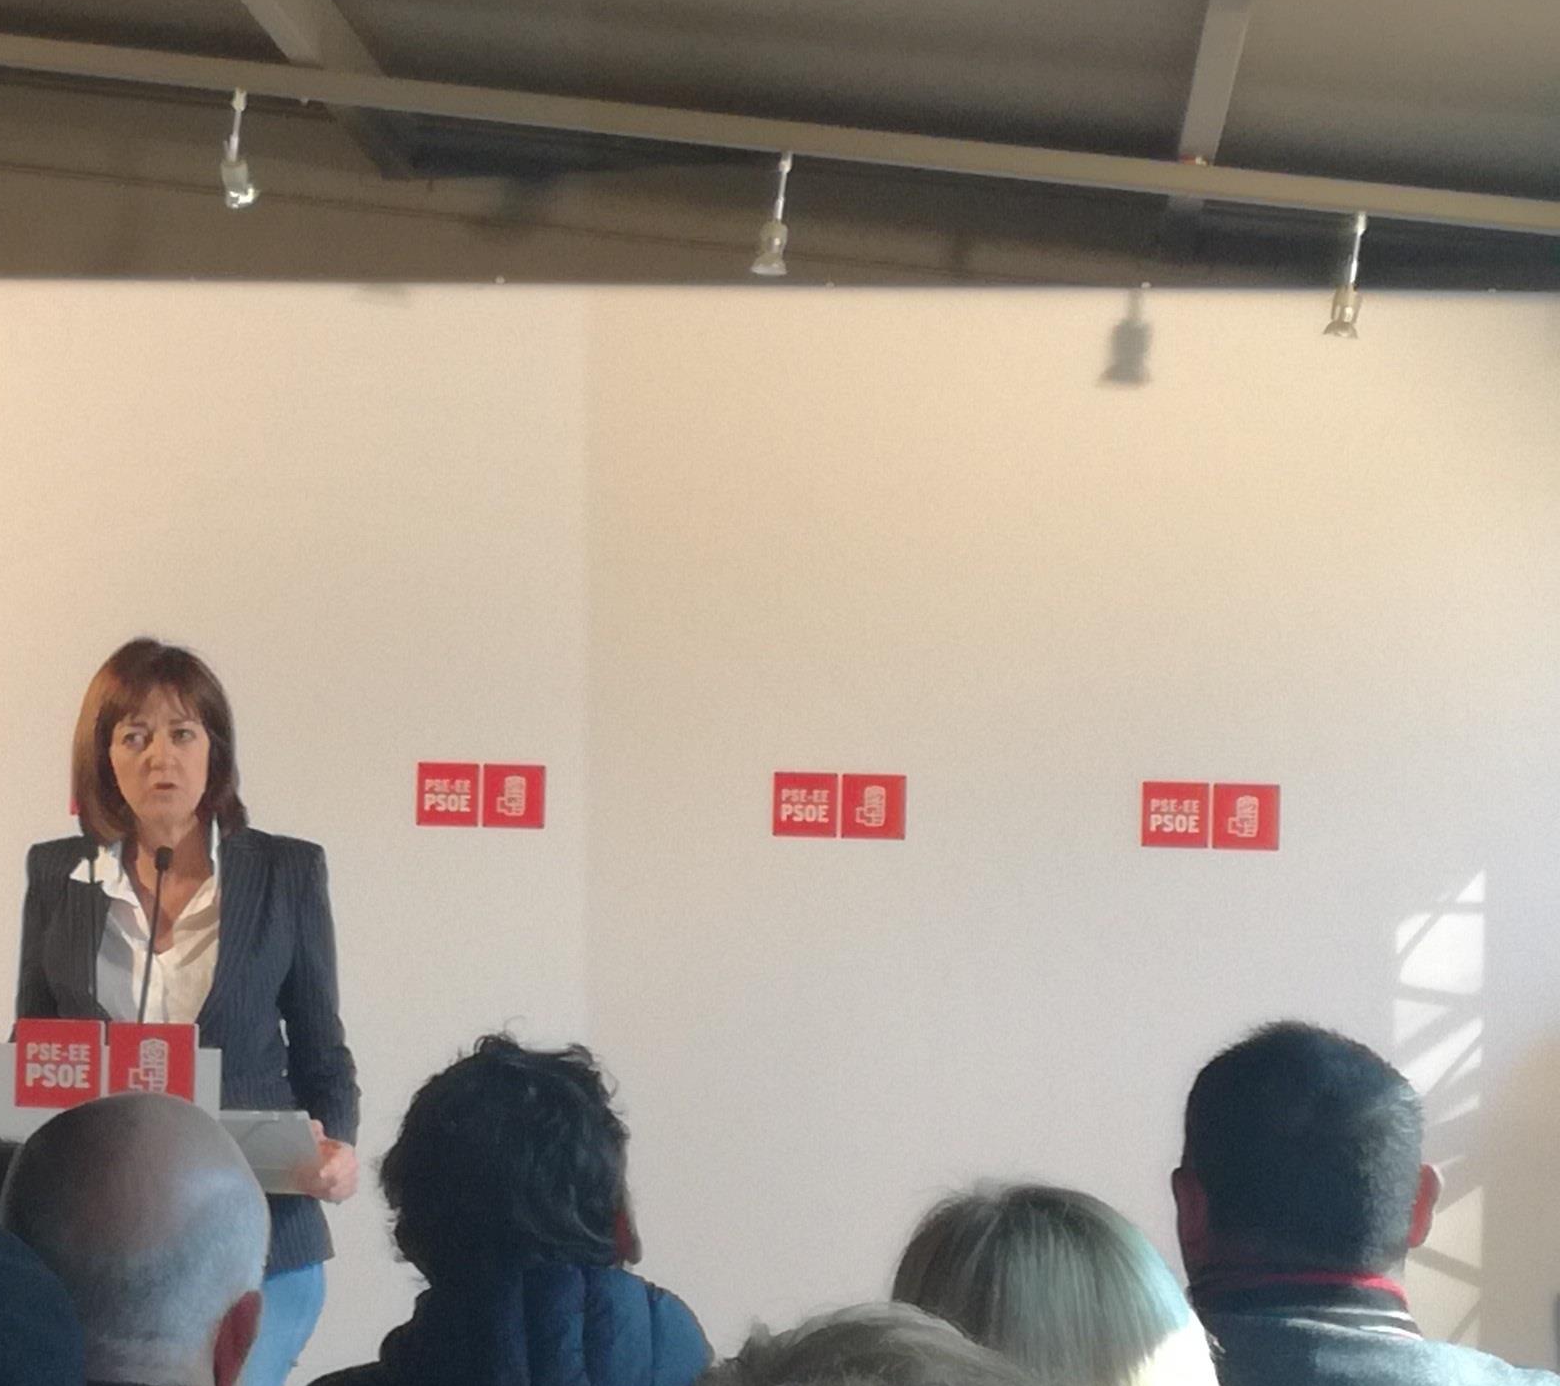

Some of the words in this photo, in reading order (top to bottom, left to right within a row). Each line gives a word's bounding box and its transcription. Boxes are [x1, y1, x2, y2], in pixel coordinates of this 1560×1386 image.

[424, 793, 471, 812] PSOE
[1150, 798, 1200, 813] PSE-EE
[780, 804, 829, 823] PSOE
[1149, 813, 1200, 833] PSOE
[26, 1042, 90, 1062] PSE-EE
[25, 1063, 90, 1089] PSOE
